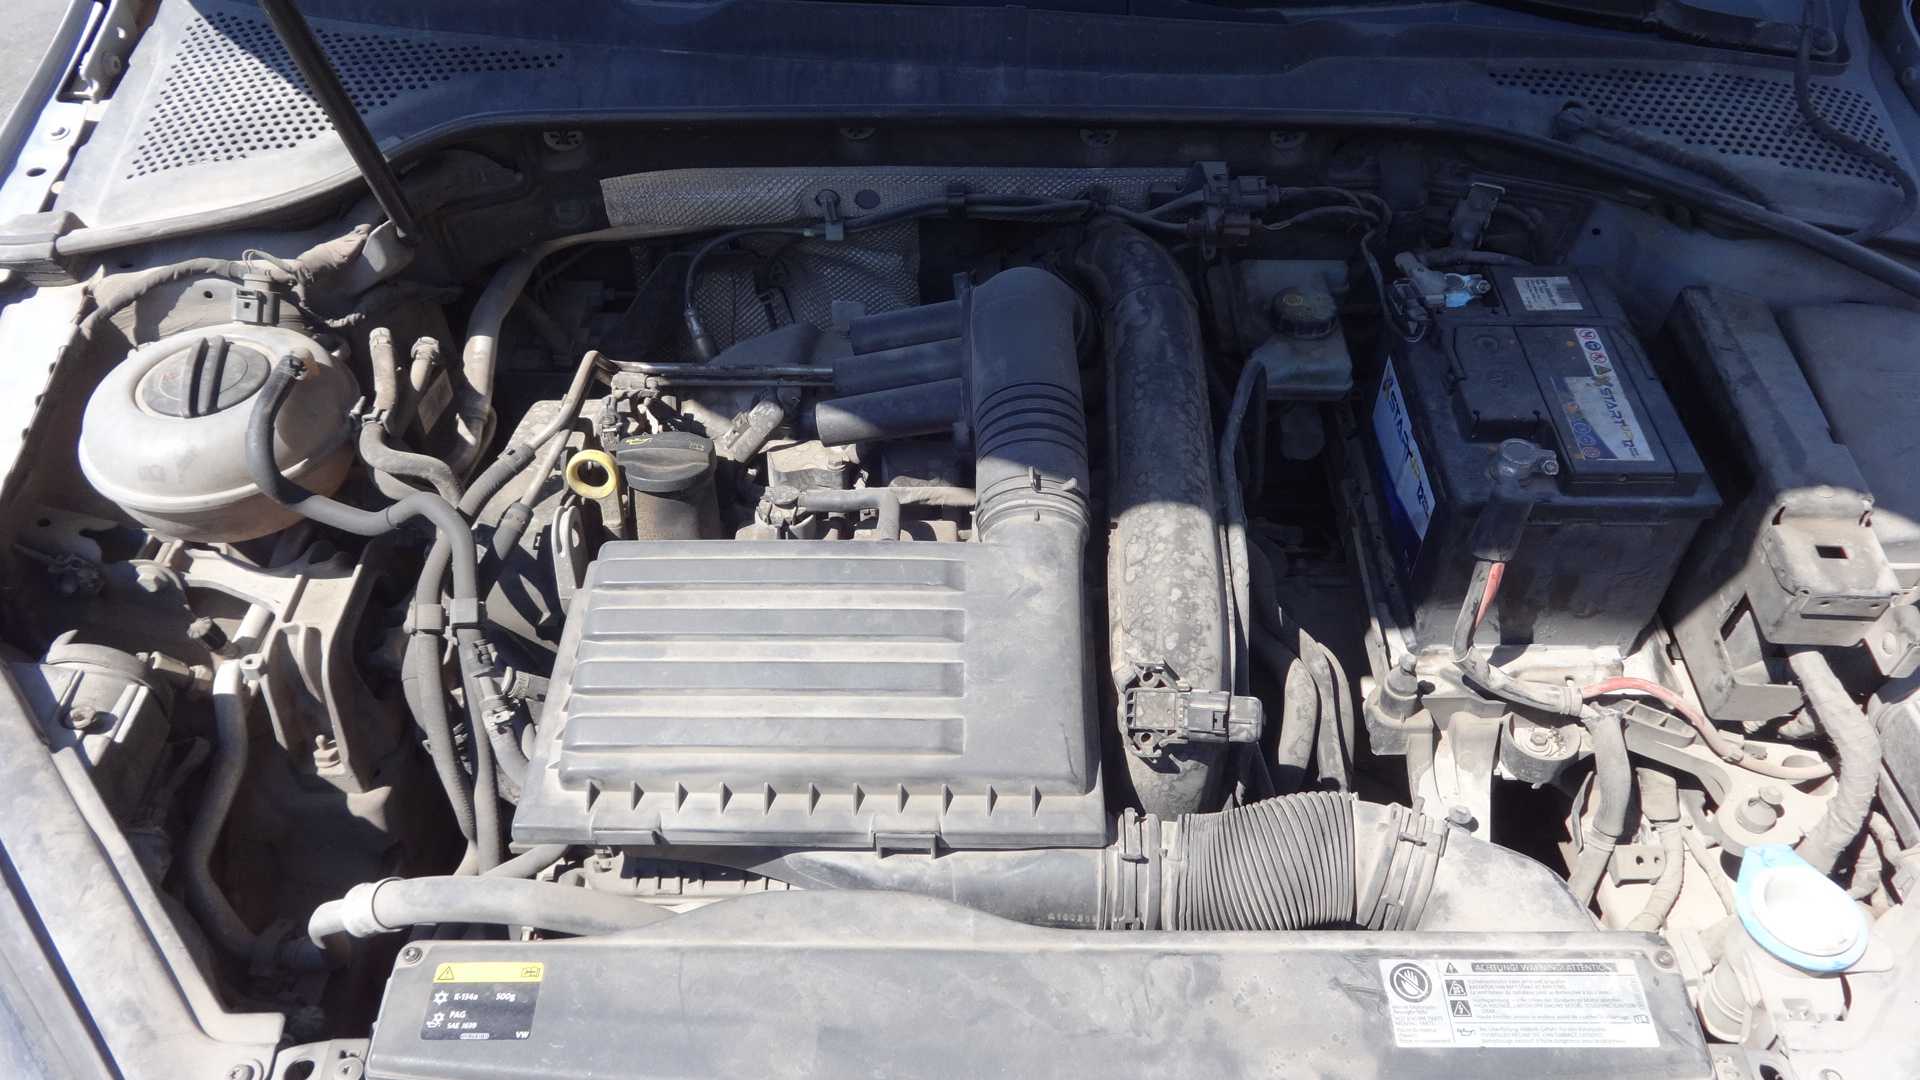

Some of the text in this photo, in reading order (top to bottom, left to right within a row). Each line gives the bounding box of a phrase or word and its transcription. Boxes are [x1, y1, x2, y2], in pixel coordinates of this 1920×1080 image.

[1475, 963, 1615, 972] ACHTUNG! WARNING! ATTENTION!
[453, 993, 516, 1002] R-134a 500g
[449, 1010, 467, 1019] PAG
[515, 1031, 530, 1039] VW
